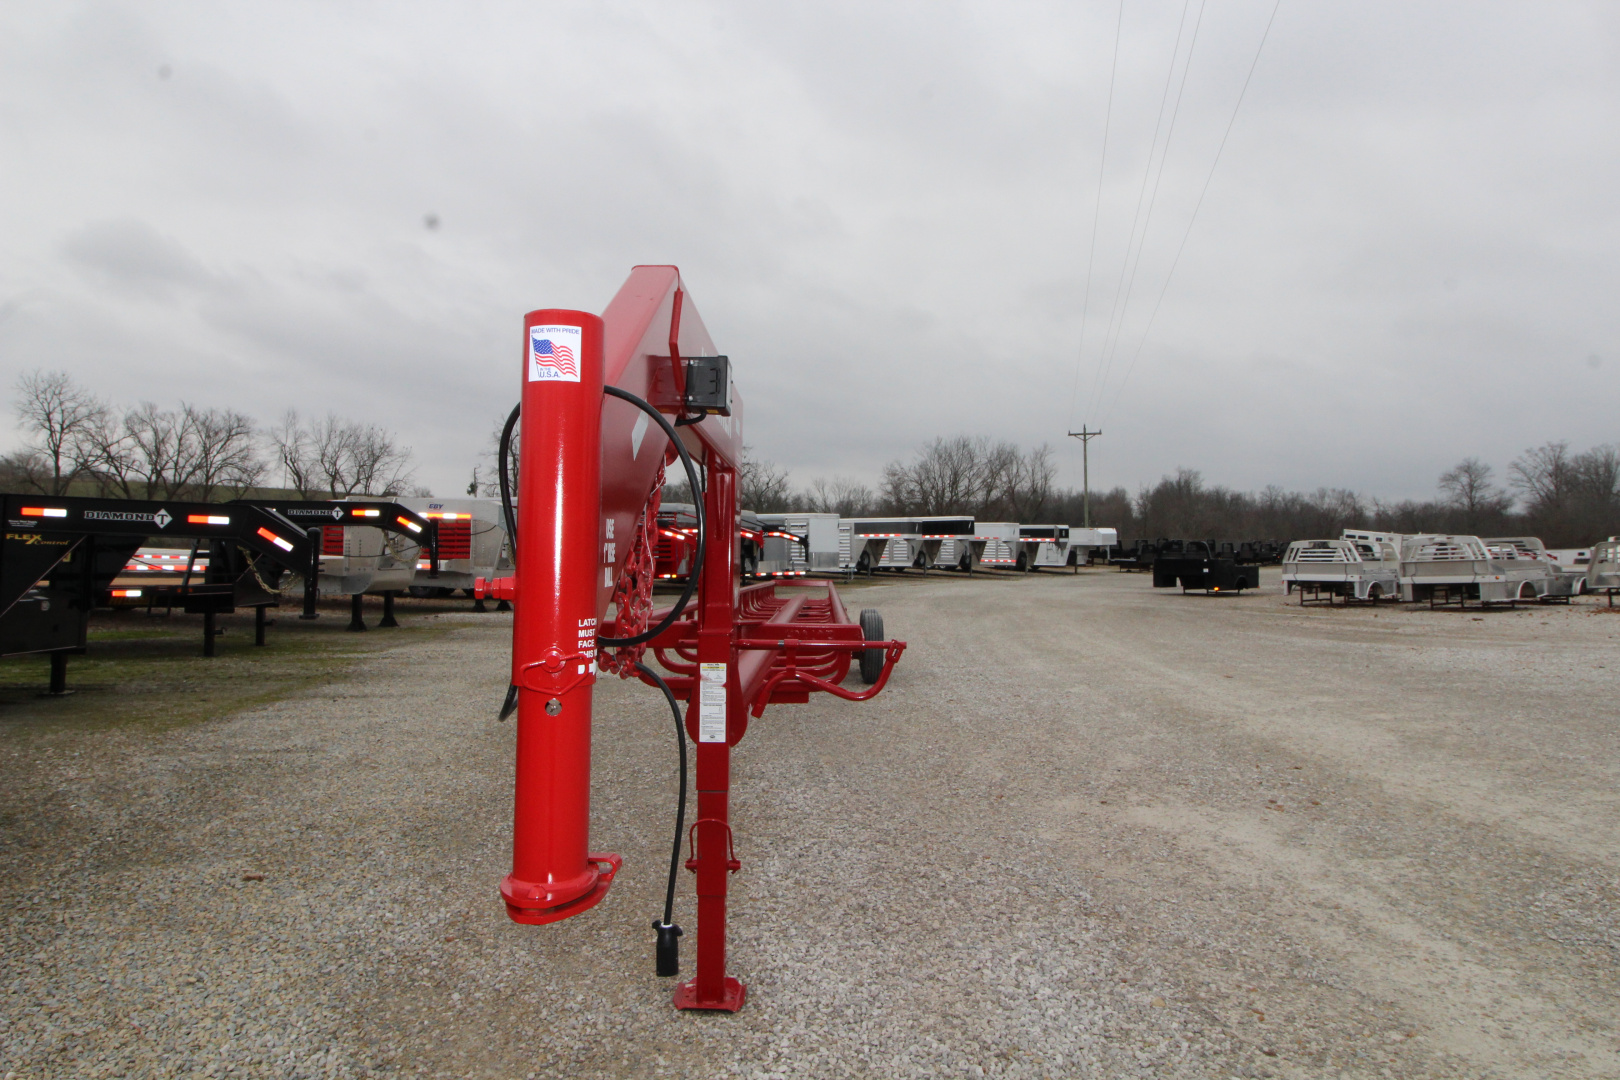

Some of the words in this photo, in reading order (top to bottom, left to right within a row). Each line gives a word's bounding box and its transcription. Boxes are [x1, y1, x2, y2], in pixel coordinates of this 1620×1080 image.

[84, 510, 156, 521] DIAMOND
[287, 508, 333, 516] DIAMOND
[5, 533, 42, 545] FLEX
[578, 628, 596, 638] MUST
[578, 639, 595, 649] FACE
